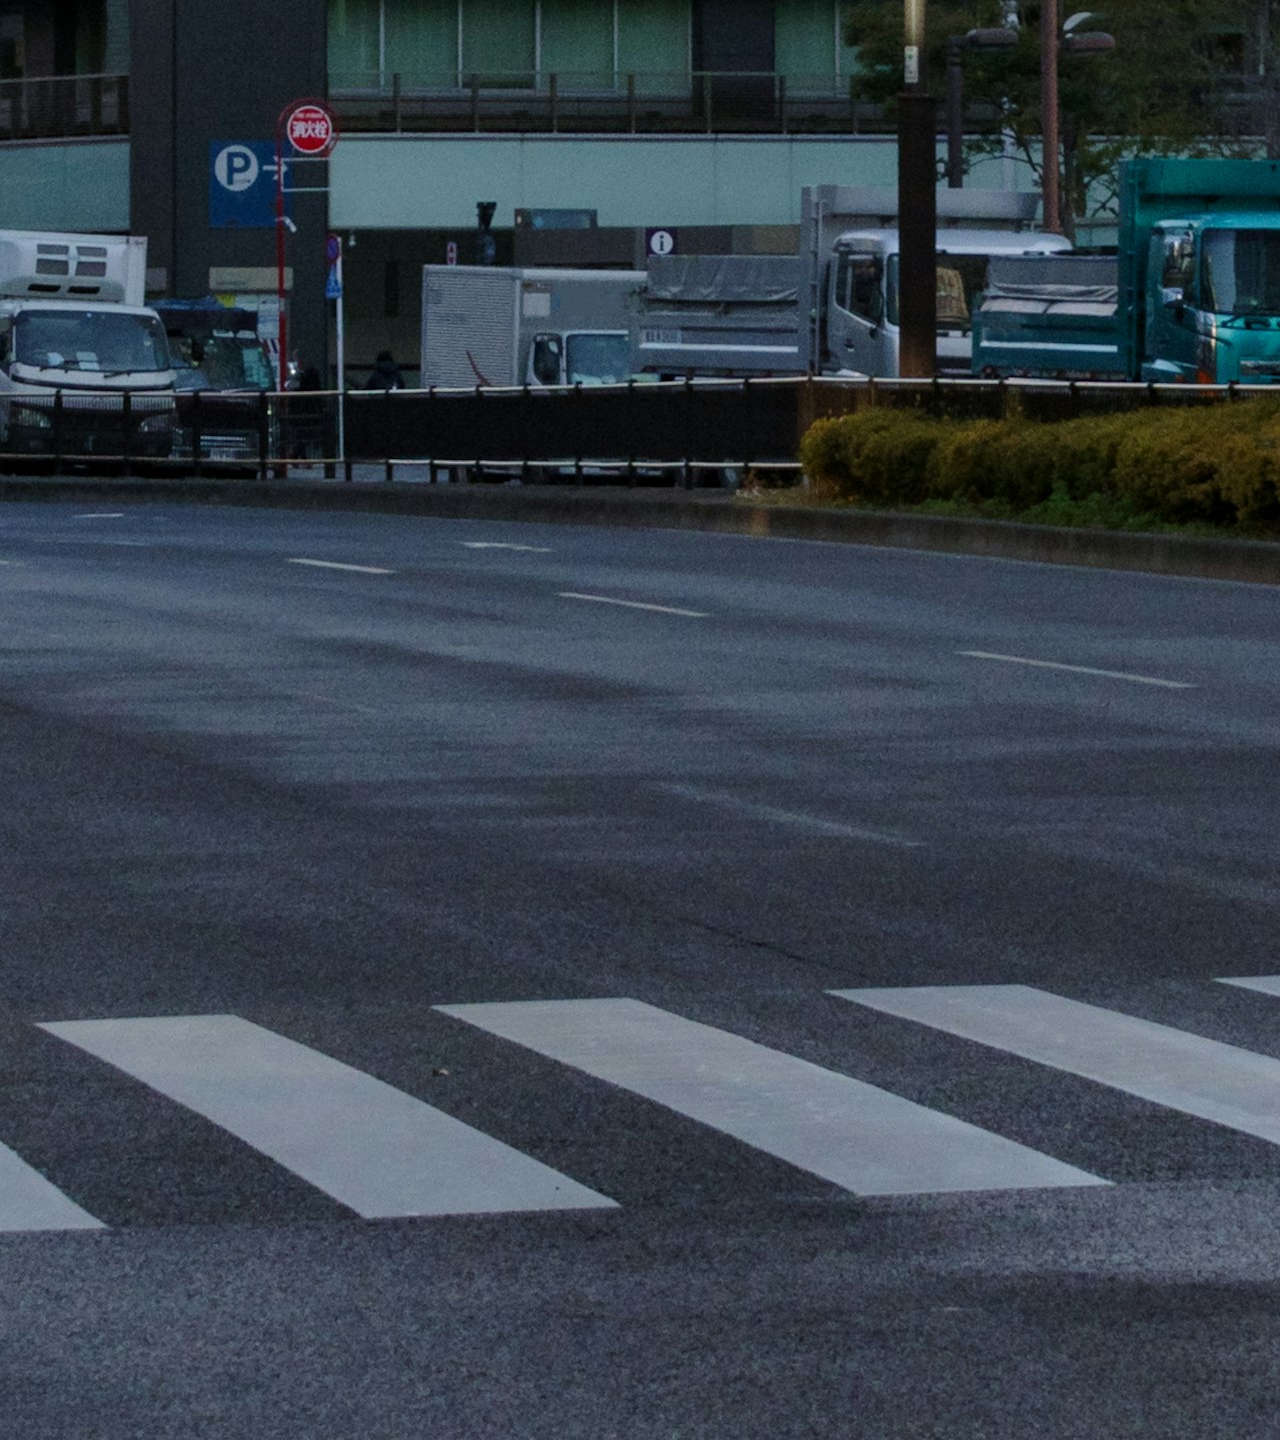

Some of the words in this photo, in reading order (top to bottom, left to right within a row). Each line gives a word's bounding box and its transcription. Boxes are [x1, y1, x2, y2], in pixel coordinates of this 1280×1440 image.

[292, 121, 327, 138] 消火栓
[227, 152, 251, 185] P
